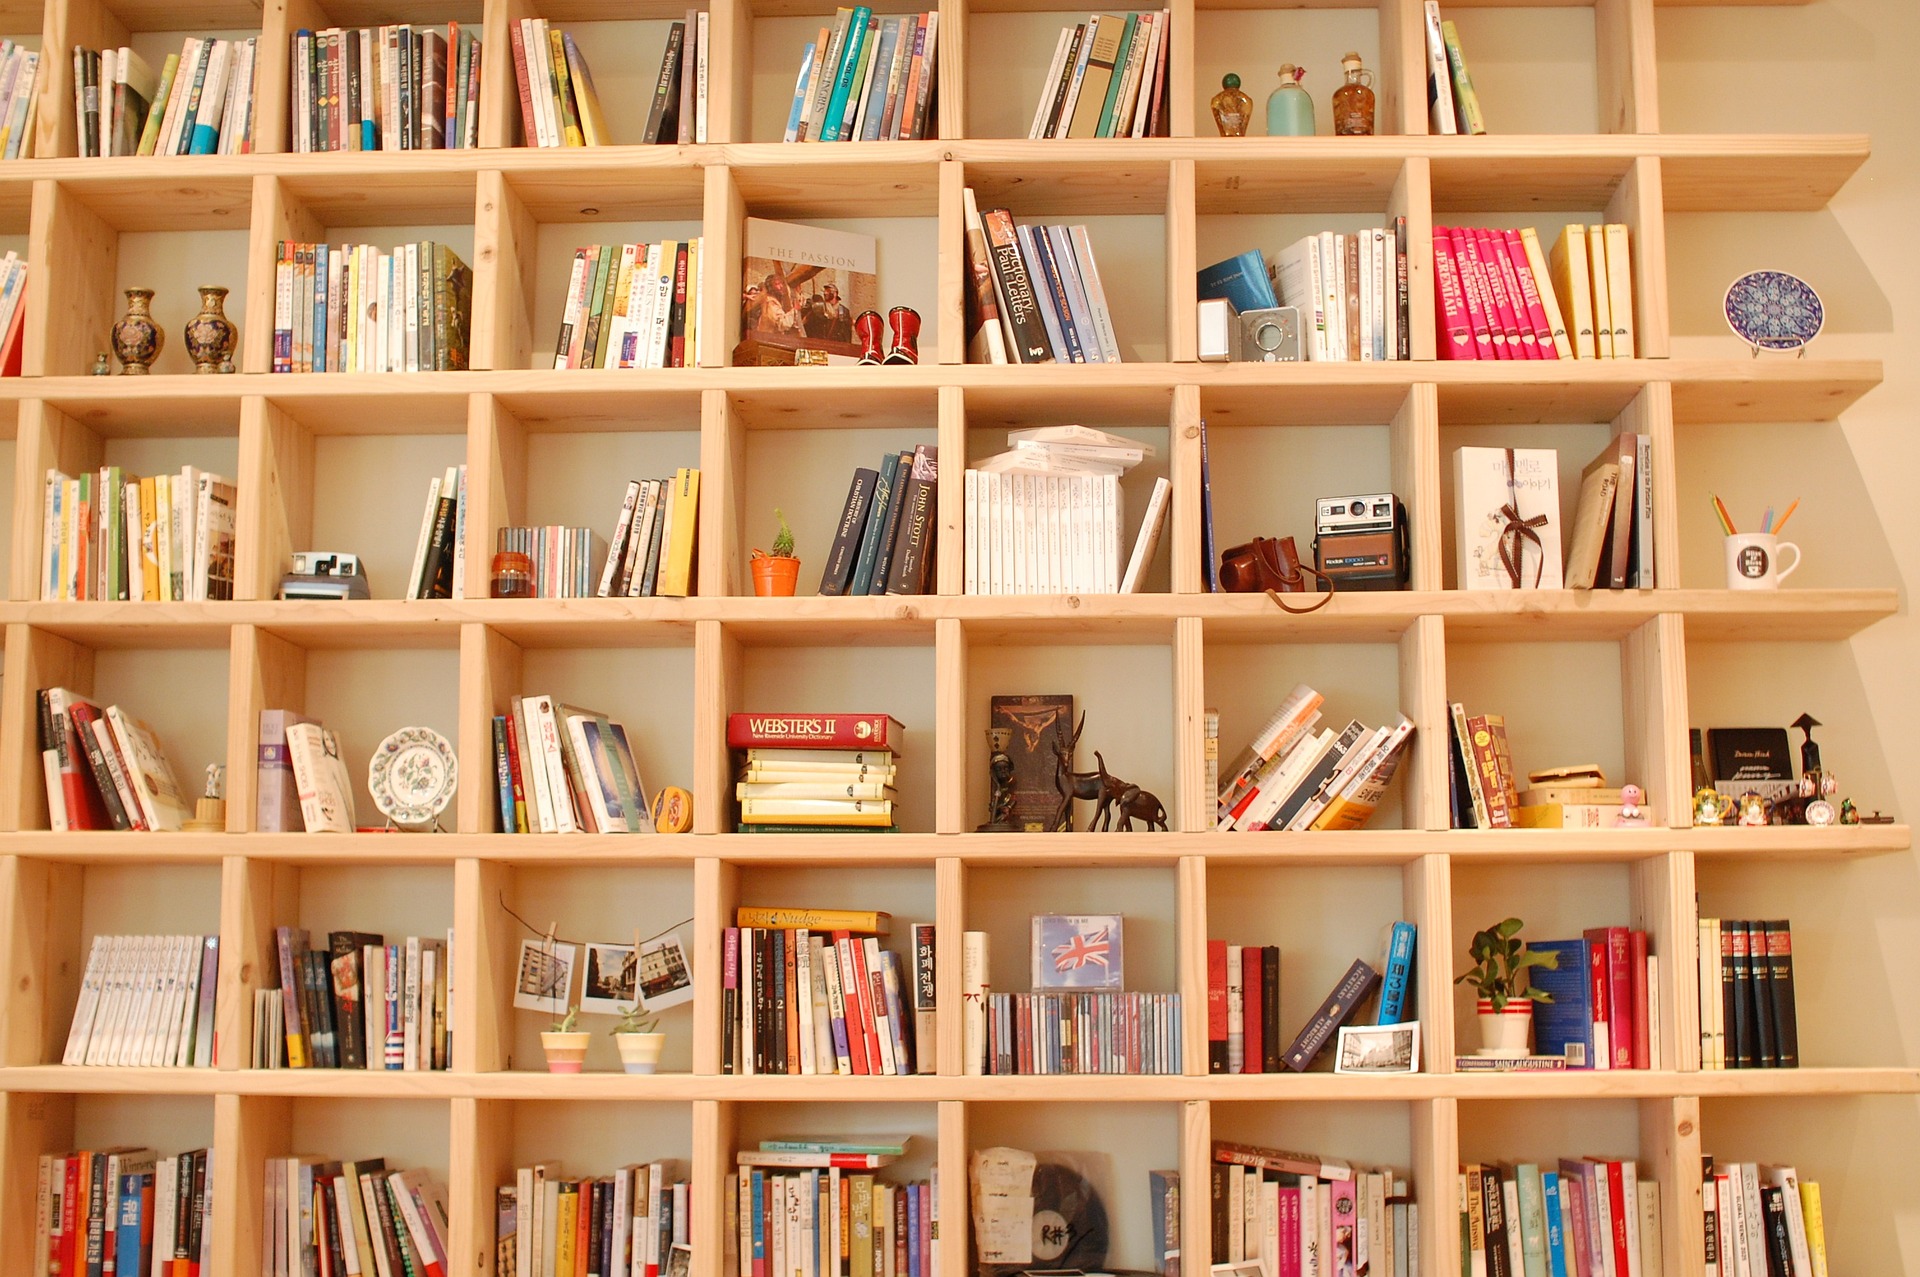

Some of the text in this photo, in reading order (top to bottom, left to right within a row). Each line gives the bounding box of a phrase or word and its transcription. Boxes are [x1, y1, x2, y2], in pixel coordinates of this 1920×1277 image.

[768, 246, 857, 268] THE PASSION
[996, 246, 1027, 324] Paul Letters
[1007, 245, 1034, 312] Dictionary
[1435, 248, 1457, 316] JEREMIAH
[1450, 273, 1460, 296] BOOK
[1455, 250, 1478, 315] DEUTERONOMY
[1484, 261, 1505, 309] LEVITICUS
[1516, 264, 1536, 307] JOSHUA
[1522, 478, 1551, 491] 이야기
[1599, 477, 1609, 497] ROAD
[1608, 471, 1617, 485] THE
[840, 478, 863, 538] CHRISTIAN DOCTRINE
[909, 483, 930, 548] JOHN STOTT
[608, 522, 626, 565] love actually
[879, 556, 887, 575] WOLFFE
[900, 548, 911, 577] Dudley-Smith
[906, 555, 915, 573] Timothy
[750, 718, 836, 734] WEBSTER'S II
[780, 911, 822, 926] Nudge
[919, 945, 934, 997] 화폐전쟁
[1335, 964, 1364, 1000] SECRETARY
[1345, 974, 1365, 999] MADAM
[776, 999, 783, 1009] 2
[1298, 1015, 1326, 1049] ALBRIGHT
[1303, 1018, 1332, 1055] MADELEINE
[1494, 1059, 1513, 1069] SAINT
[1516, 1059, 1553, 1069] AUGUSTINE
[120, 1158, 155, 1173] Winners
[1233, 1153, 1266, 1167] 공부기술
[852, 1181, 871, 1217] 모방범
[1469, 1196, 1479, 1214] The
[122, 1200, 138, 1226] 유럽
[1041, 1223, 1077, 1247] R#3
[1705, 1215, 1714, 1259] 북한 현대사
[1737, 1220, 1745, 1244] TRENDS
